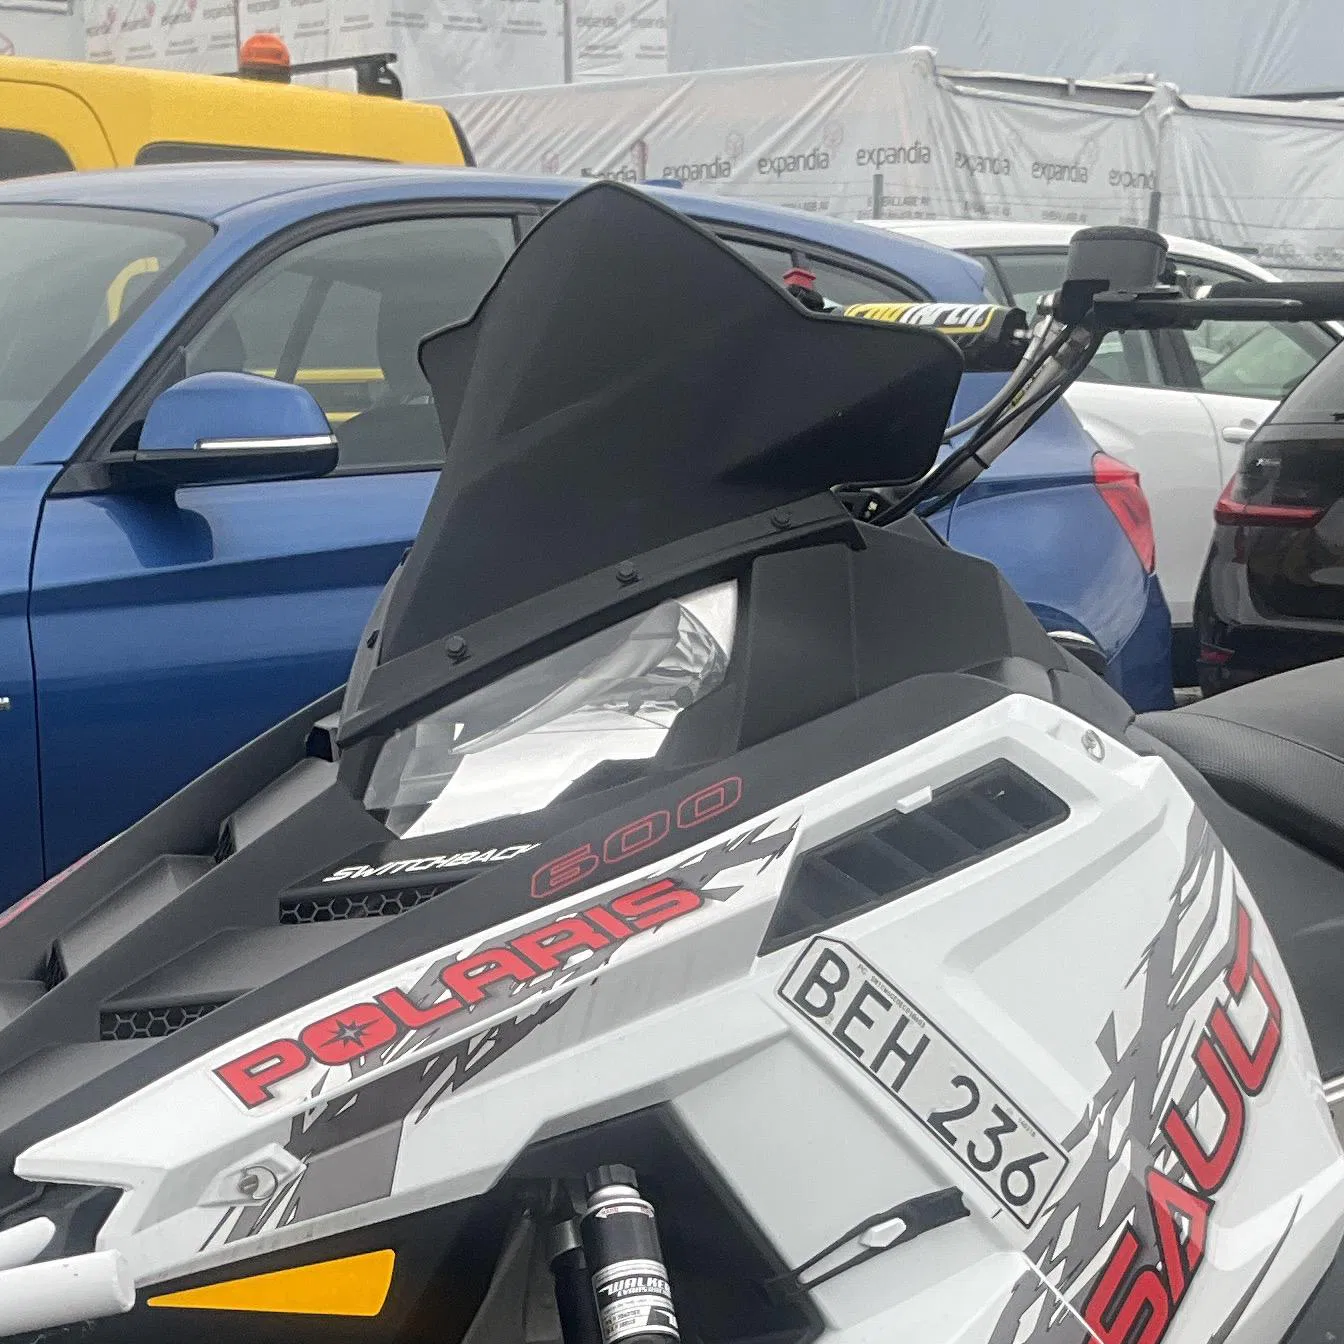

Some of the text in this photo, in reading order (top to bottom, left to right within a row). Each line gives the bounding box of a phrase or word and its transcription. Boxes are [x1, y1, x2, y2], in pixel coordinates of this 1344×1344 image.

[663, 156, 732, 182] expandia
[758, 148, 830, 176] expandia
[856, 140, 931, 172] expandia
[531, 776, 743, 899] 600
[211, 877, 708, 1111] POLARIS
[792, 946, 932, 1094] BEH
[926, 1074, 1052, 1208] 236
